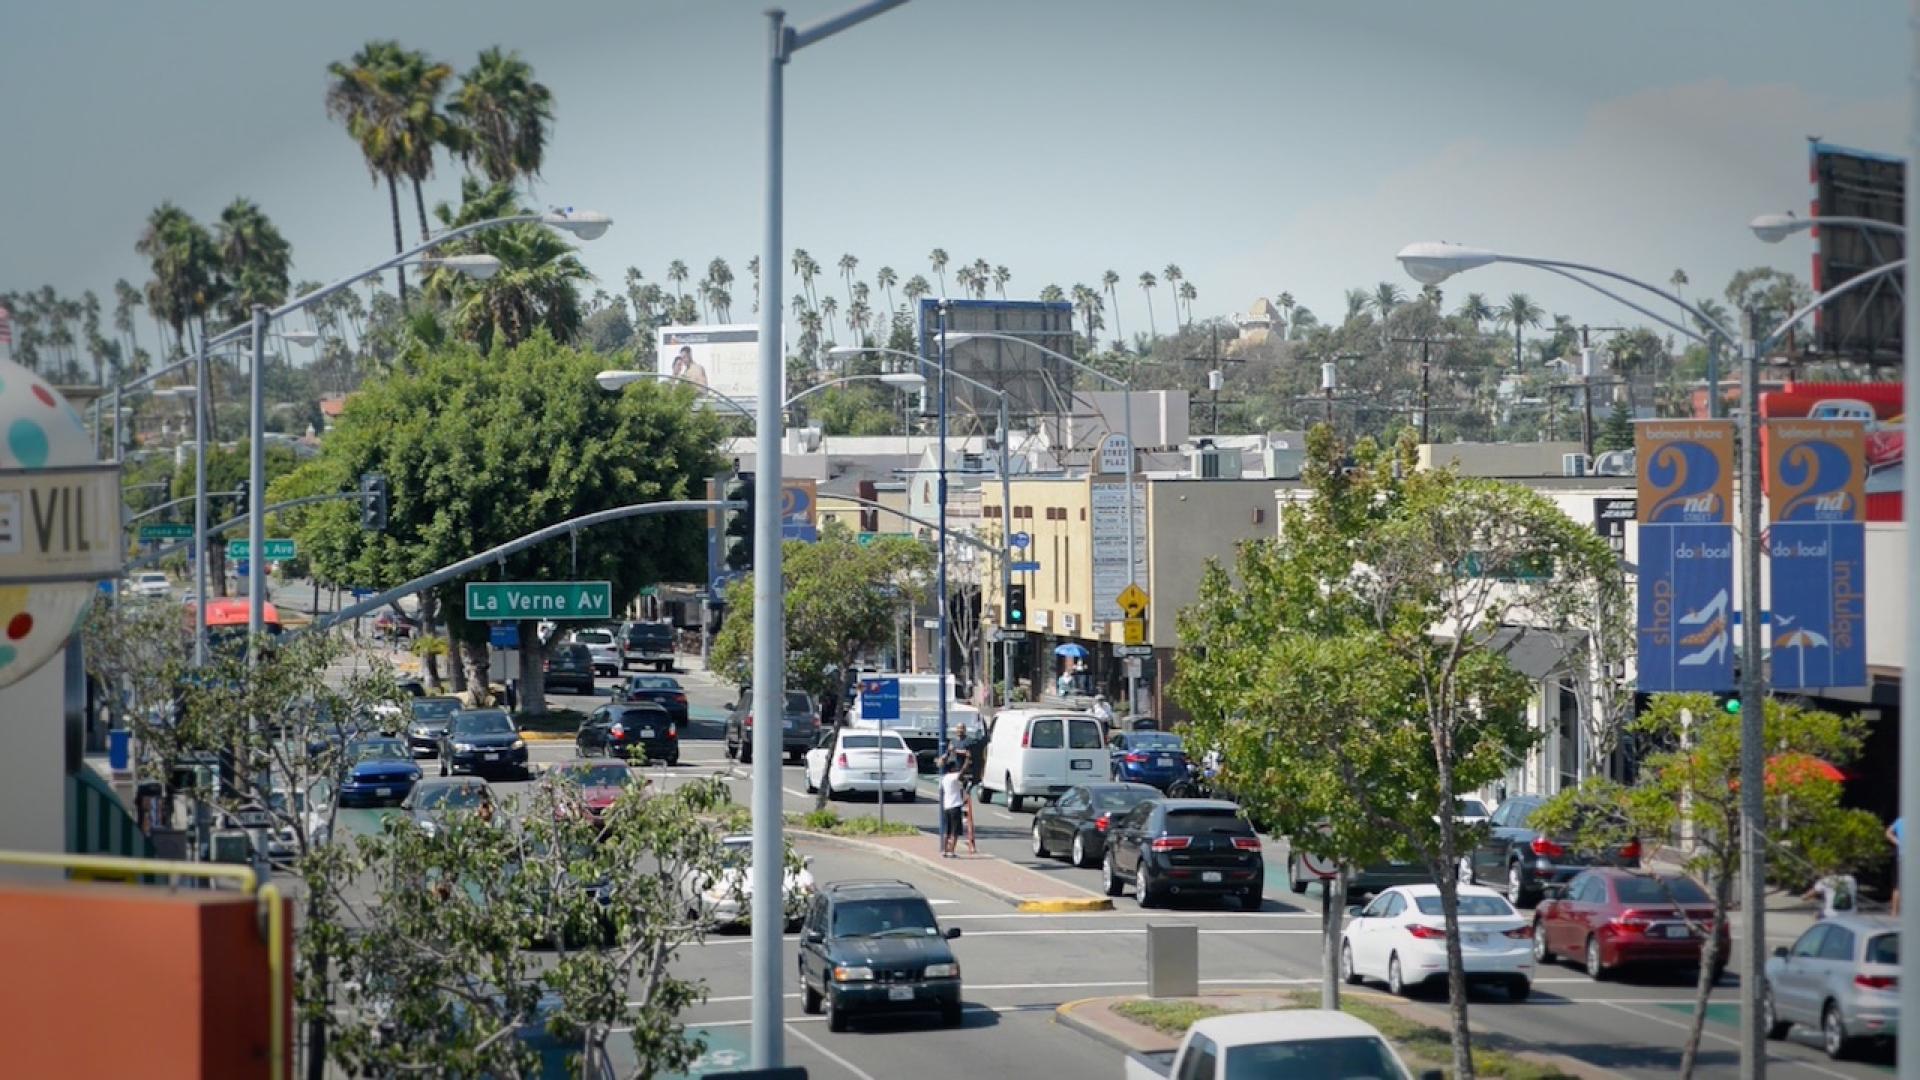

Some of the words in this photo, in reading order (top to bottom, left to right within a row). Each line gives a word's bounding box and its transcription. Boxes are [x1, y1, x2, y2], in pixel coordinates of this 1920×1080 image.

[272, 542, 292, 554] Ave
[473, 592, 498, 610] La
[507, 591, 566, 610] Verne
[578, 591, 604, 609] Av
